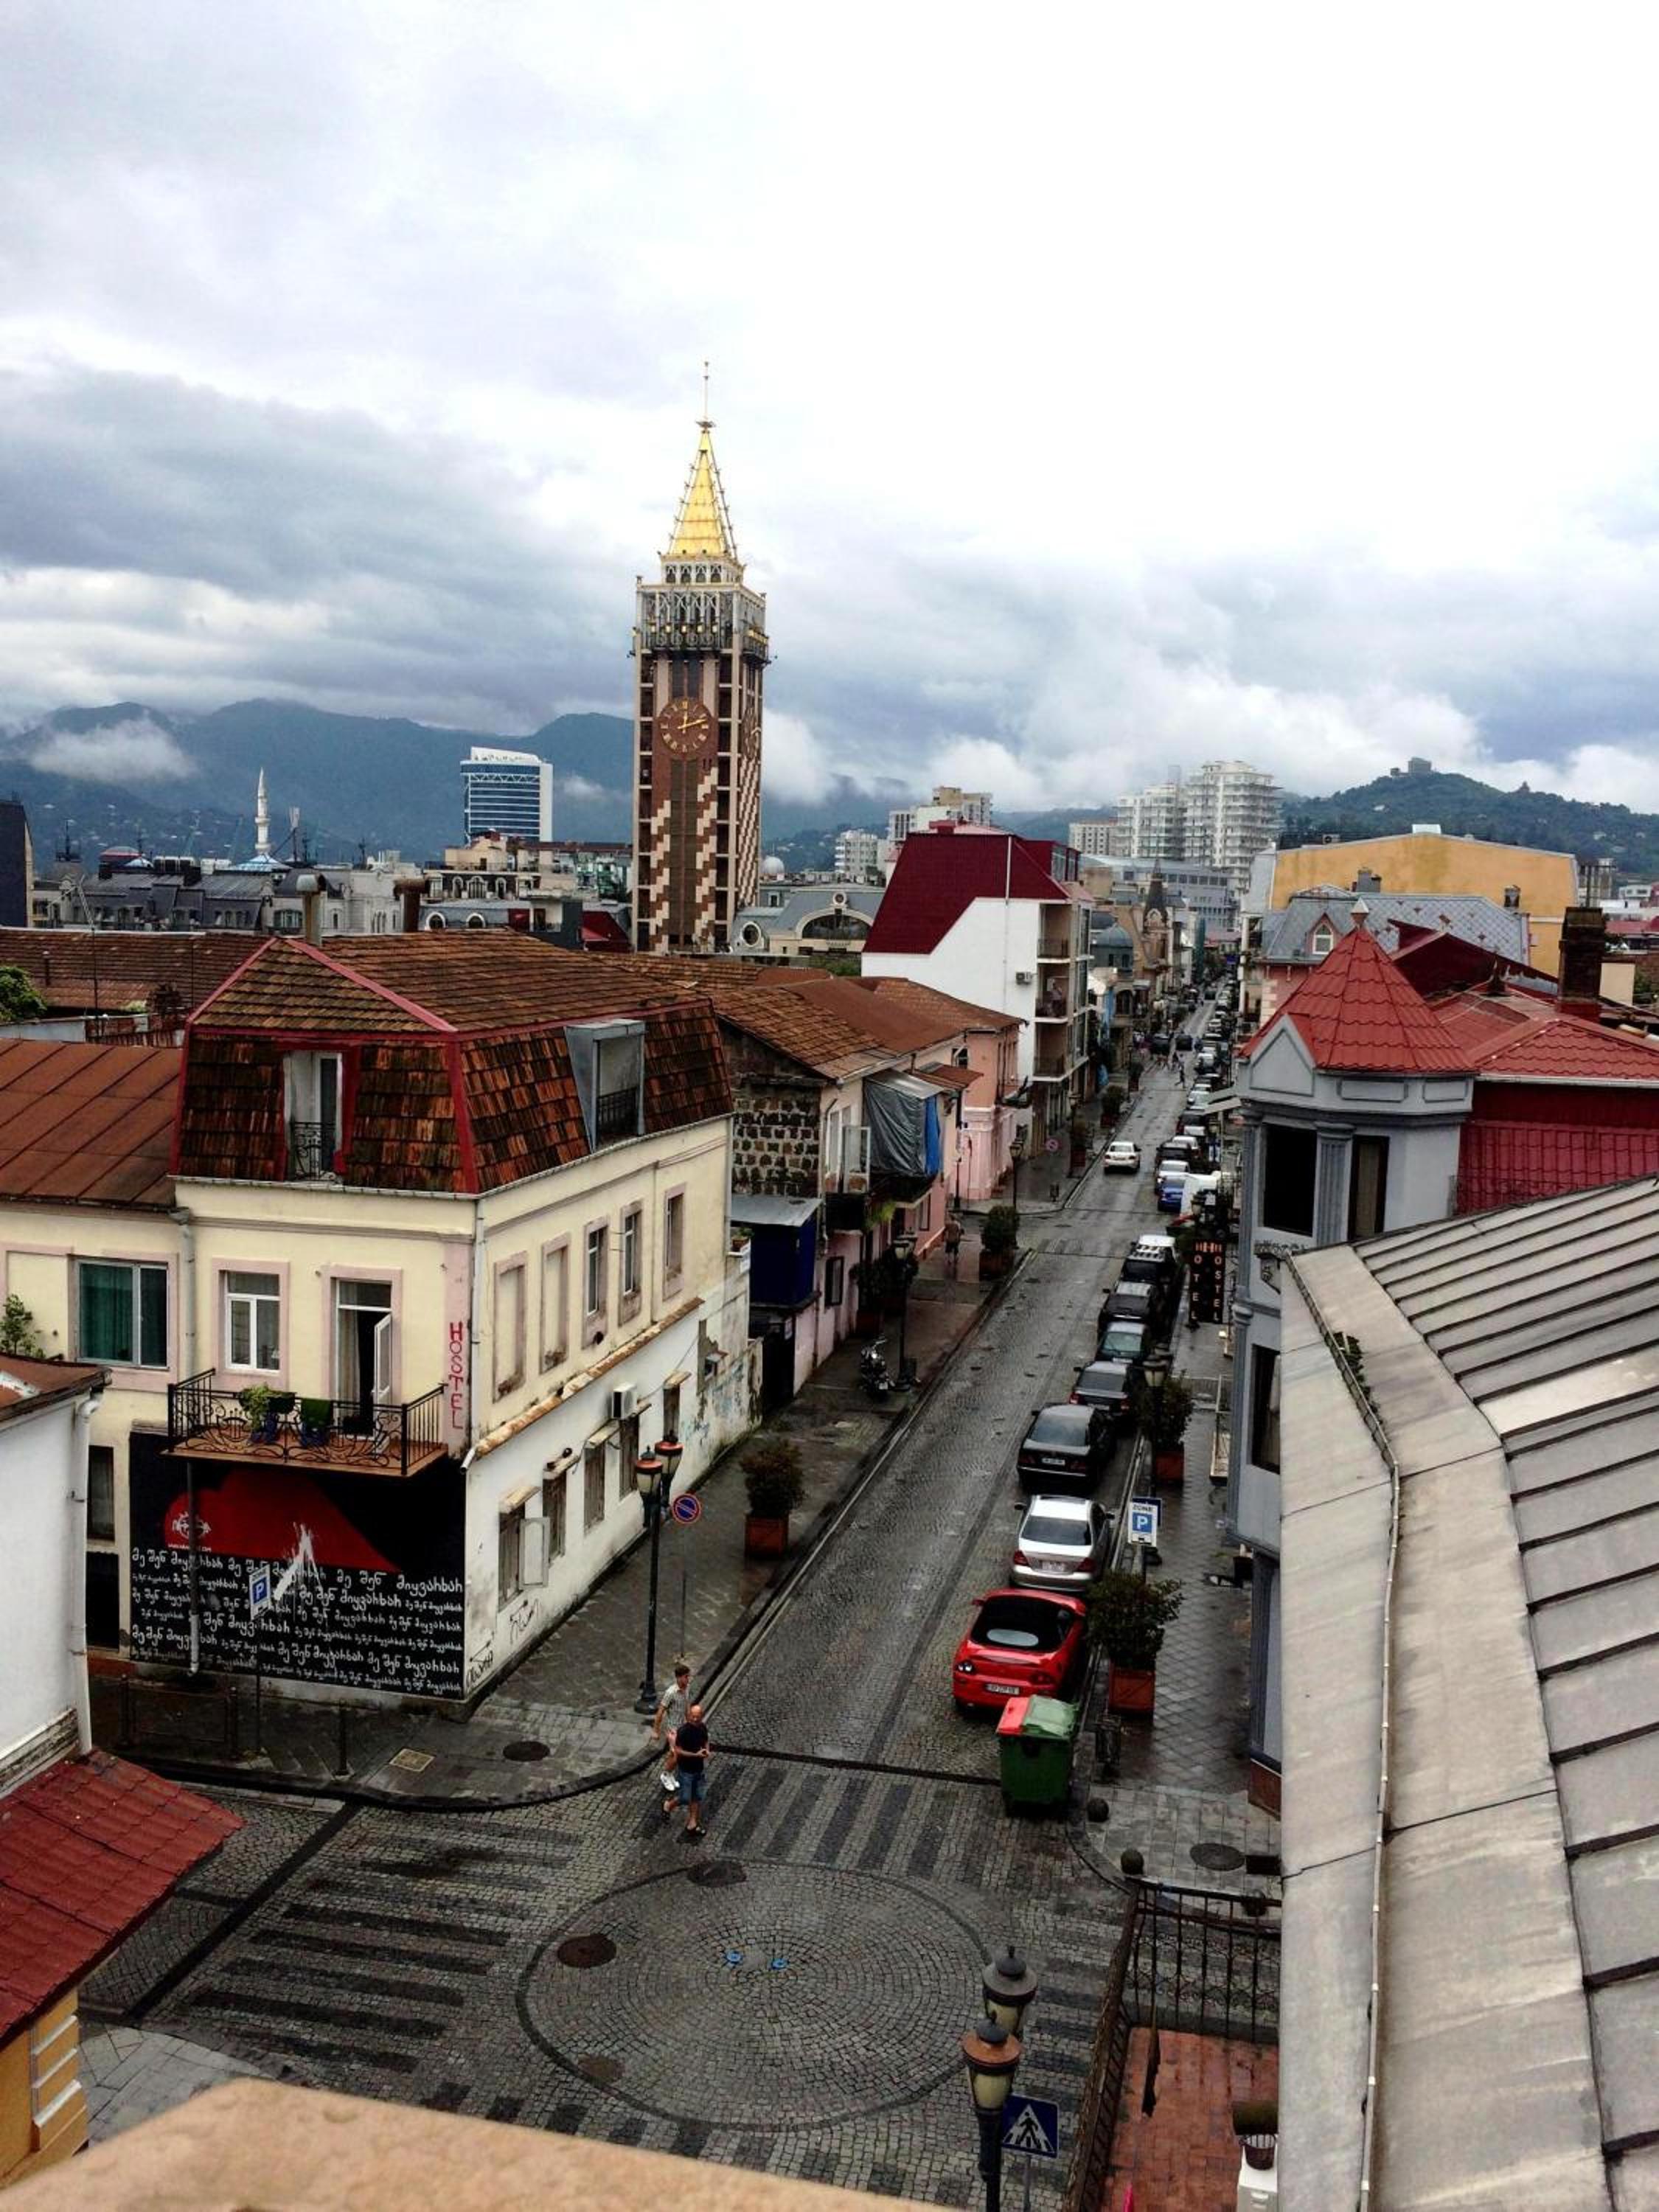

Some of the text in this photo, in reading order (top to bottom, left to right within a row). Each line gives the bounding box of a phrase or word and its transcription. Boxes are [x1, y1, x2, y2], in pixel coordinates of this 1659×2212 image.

[448, 1321, 464, 1430] HOSTEL
[1136, 1515, 1149, 1529] P
[256, 1582, 265, 1601] P
